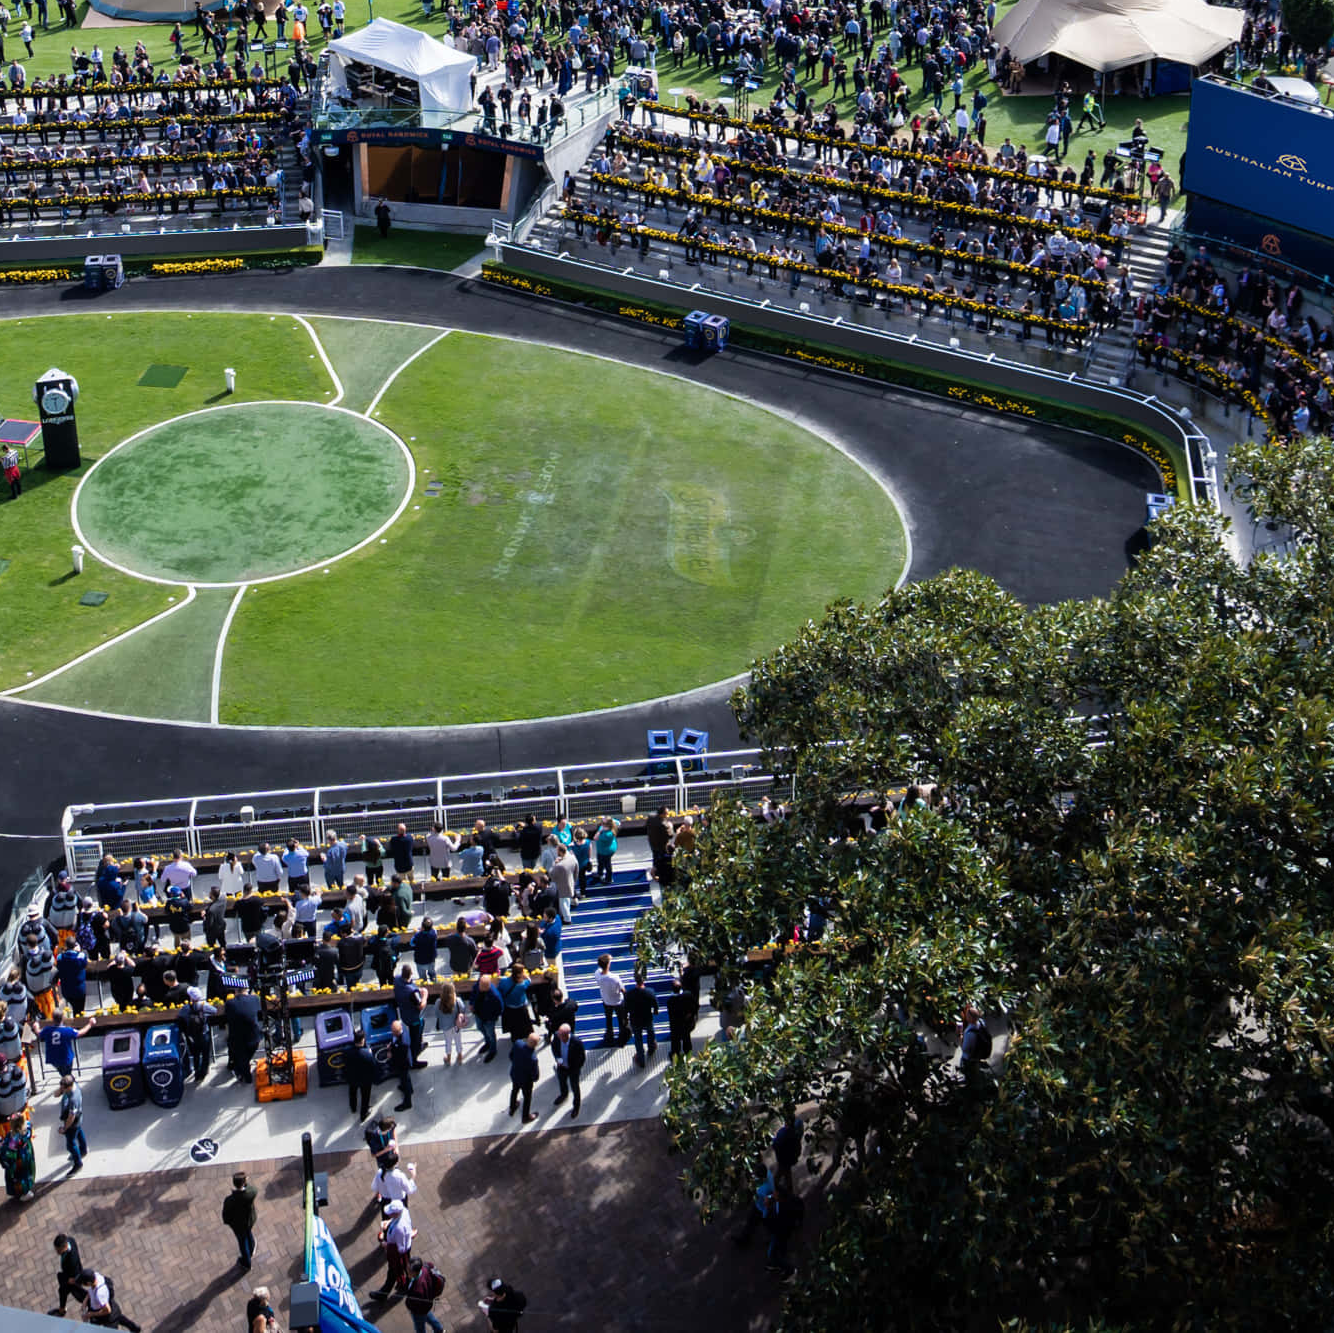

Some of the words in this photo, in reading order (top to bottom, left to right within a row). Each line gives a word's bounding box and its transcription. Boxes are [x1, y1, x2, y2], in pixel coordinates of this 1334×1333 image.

[1205, 144, 1292, 178] AUSTRALIAN
[1298, 175, 1334, 191] TURF
[51, 1031, 61, 1045] 2
